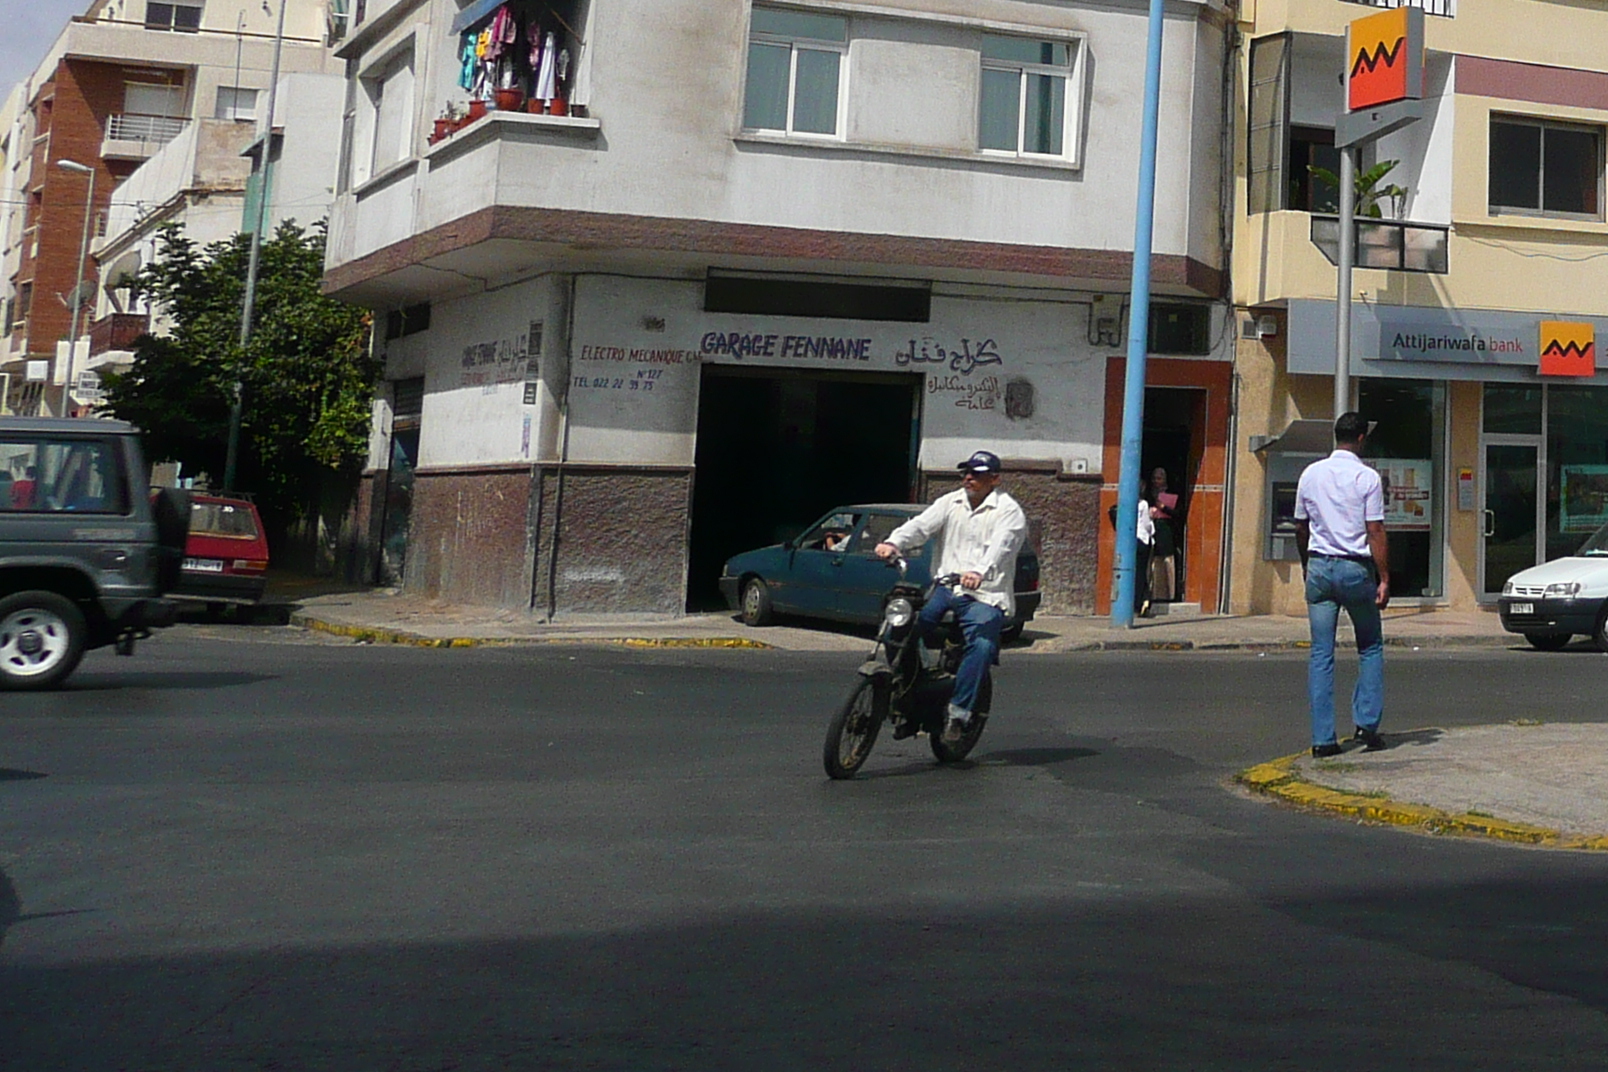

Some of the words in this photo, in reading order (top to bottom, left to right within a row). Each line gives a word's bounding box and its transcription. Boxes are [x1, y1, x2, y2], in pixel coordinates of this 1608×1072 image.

[701, 332, 779, 359] GARAGE
[780, 336, 872, 361] FENNANE
[1393, 333, 1486, 352] Attijariwafa
[1489, 336, 1523, 353] bank
[581, 345, 625, 362] ELECTRO
[628, 349, 685, 365] MECANIQUE
[573, 376, 588, 388] TEL
